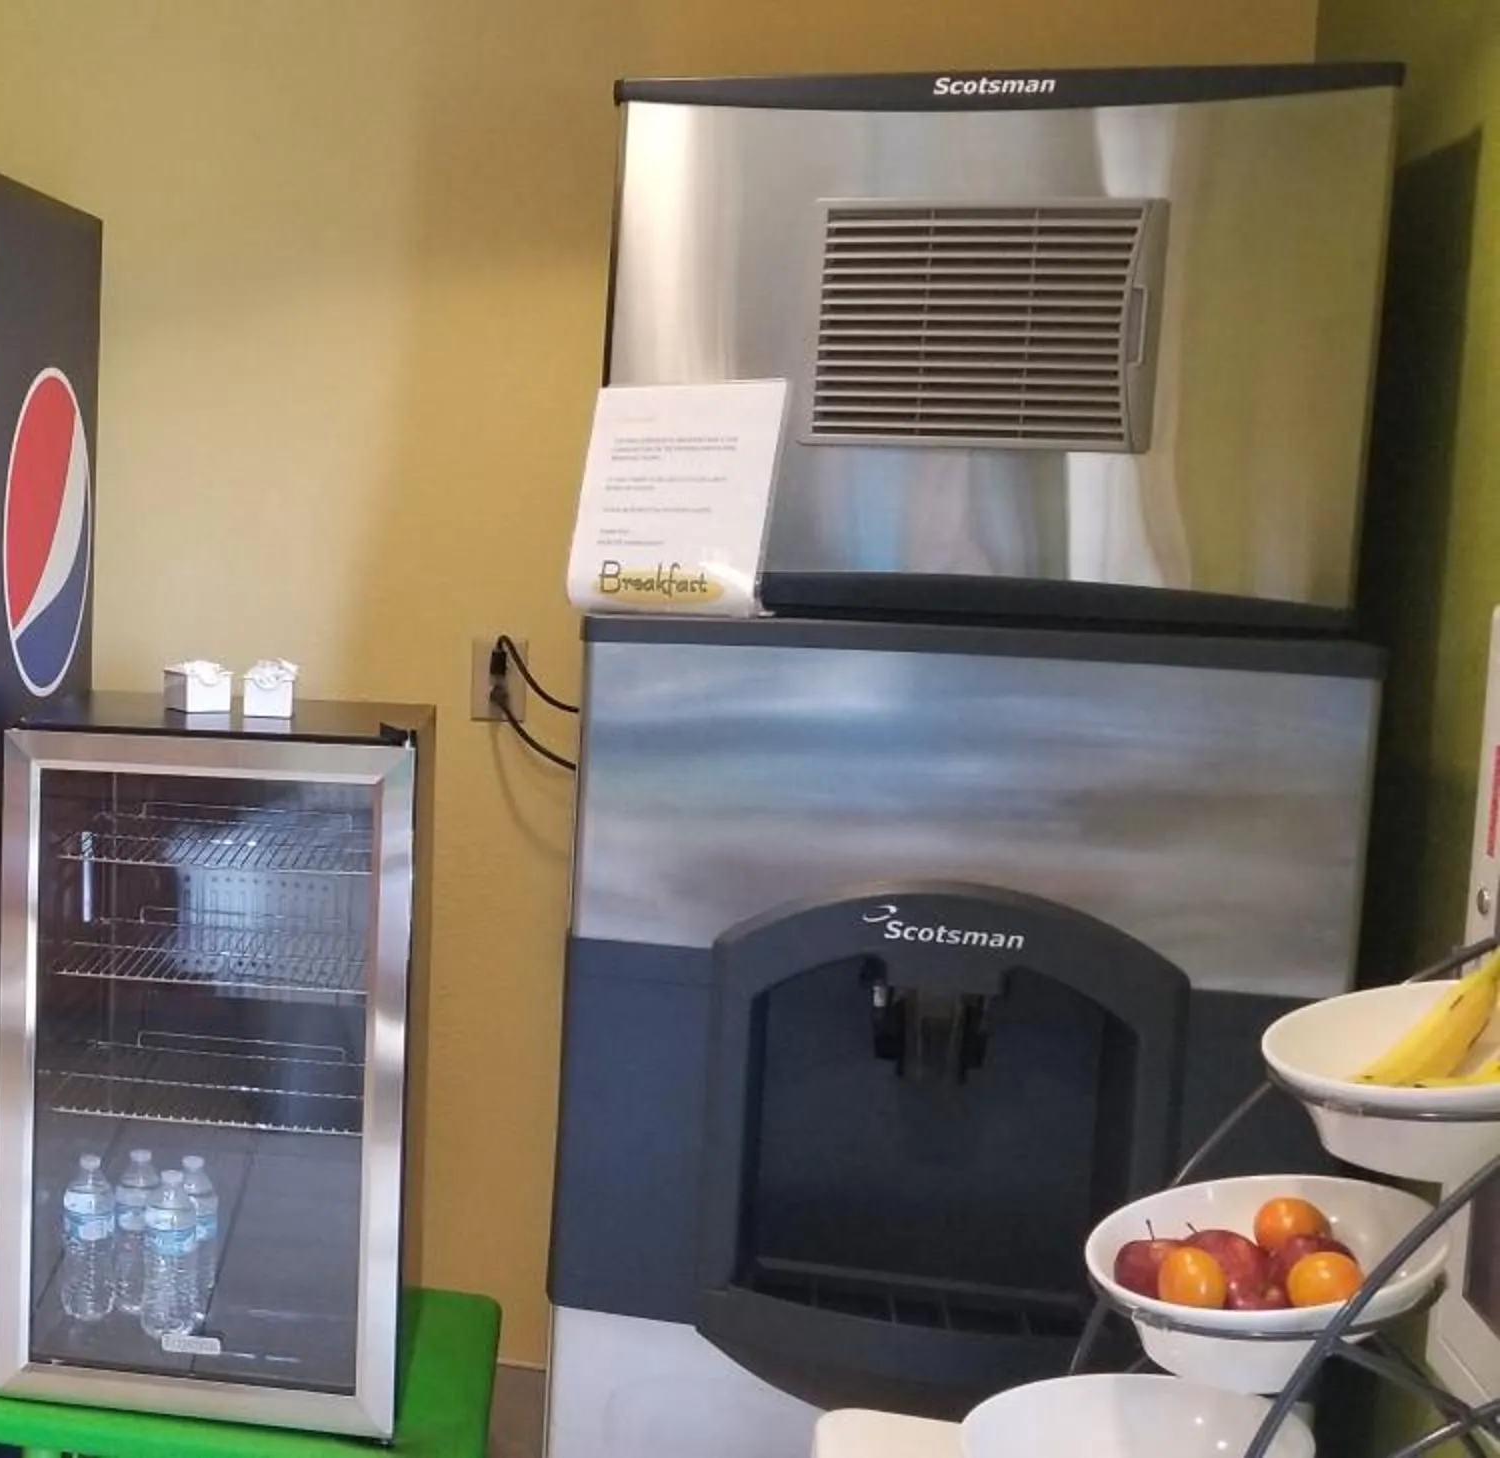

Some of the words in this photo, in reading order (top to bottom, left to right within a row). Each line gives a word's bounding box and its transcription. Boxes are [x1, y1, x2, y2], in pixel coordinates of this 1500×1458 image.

[933, 76, 1057, 96] Scotsman
[599, 560, 708, 597] Breakfast
[883, 920, 1026, 950] Scotsman
